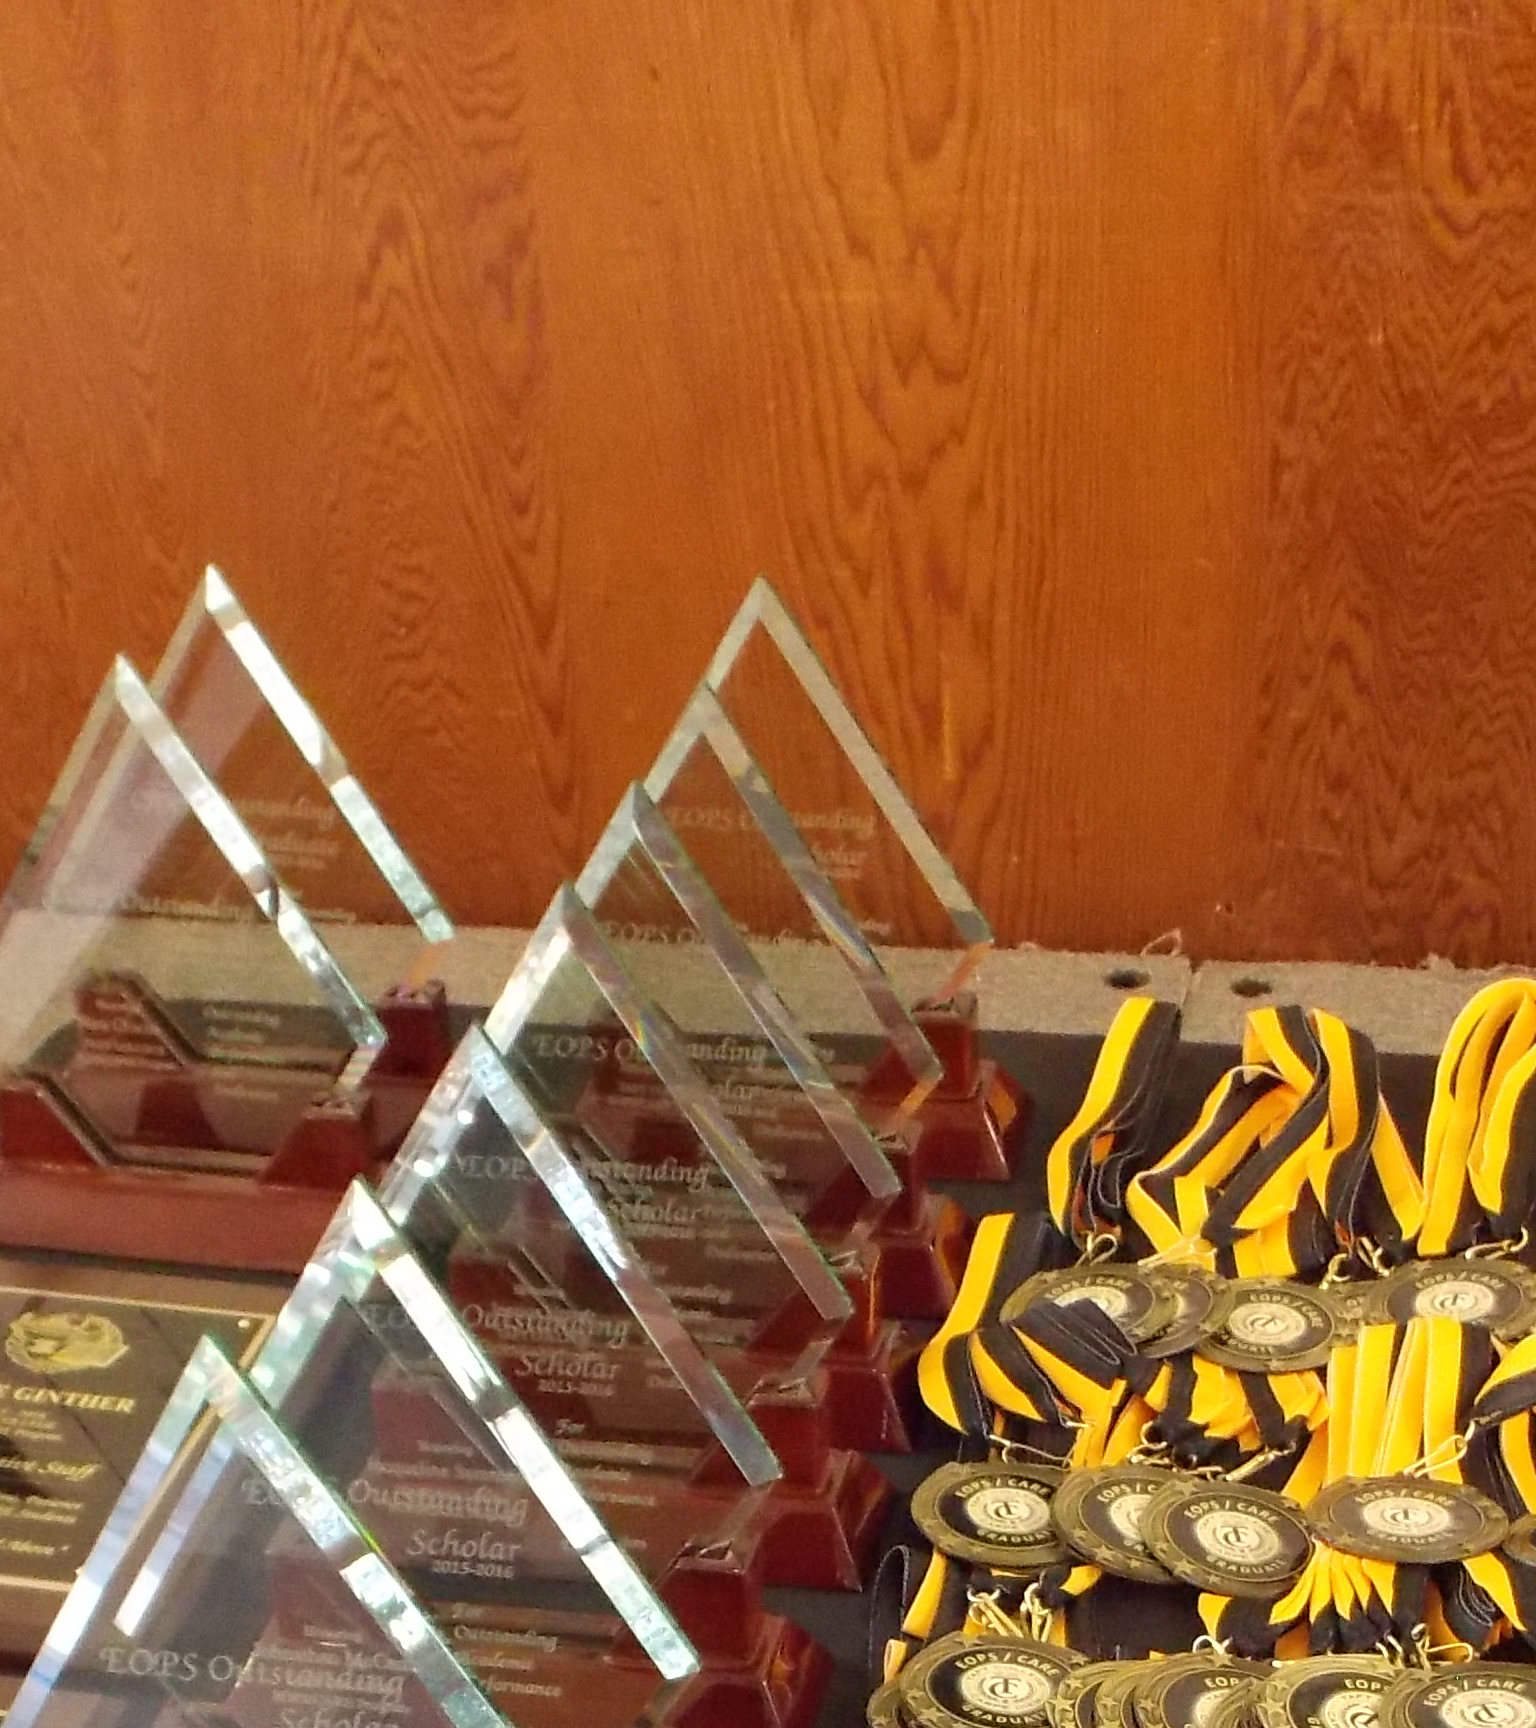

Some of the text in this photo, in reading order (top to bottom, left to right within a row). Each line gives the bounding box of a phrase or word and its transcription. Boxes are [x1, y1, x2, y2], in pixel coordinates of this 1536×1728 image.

[464, 1303, 629, 1348] Outstanding
[515, 1352, 619, 1379] Scholar
[13, 1386, 136, 1415] GINTHER
[348, 1478, 531, 1528] Outstanding
[1184, 1500, 1220, 1519] EOPS
[407, 1528, 521, 1561] Scholar
[954, 1653, 998, 1669] EOPS
[99, 1648, 406, 1704] EOPS Outstanding
[1205, 1677, 1240, 1688] EOP
[1344, 1679, 1381, 1690] EOP
